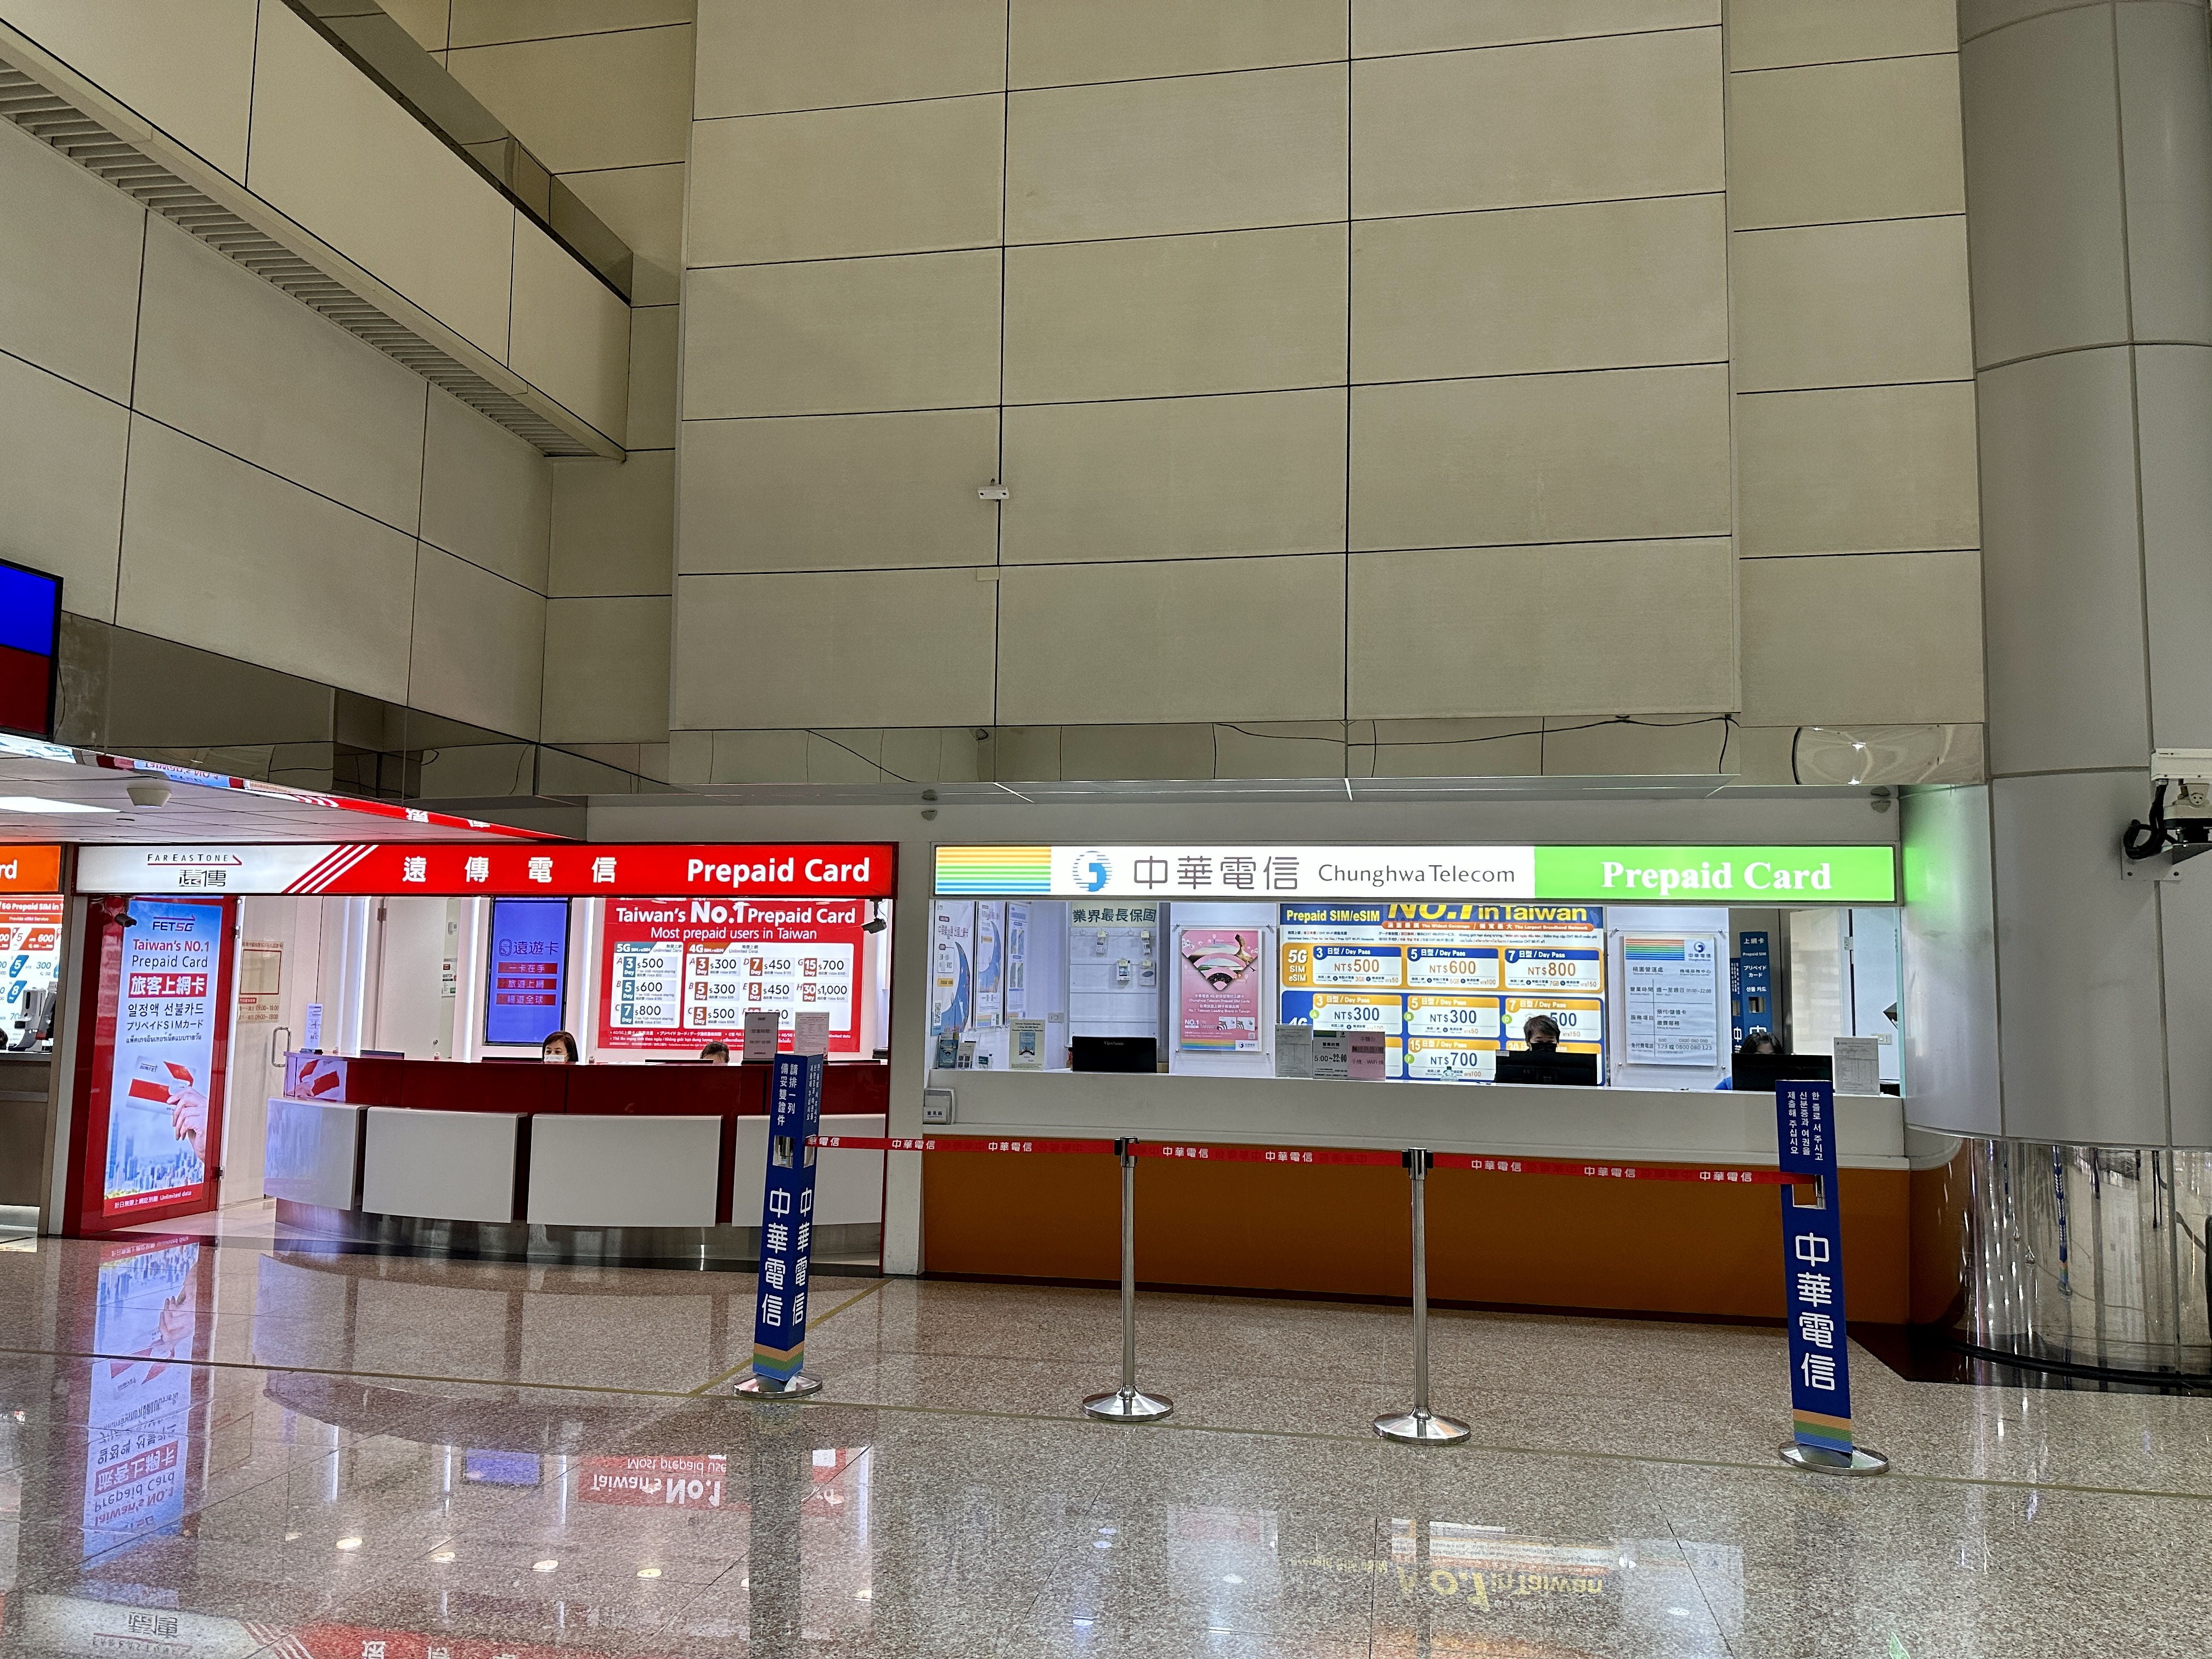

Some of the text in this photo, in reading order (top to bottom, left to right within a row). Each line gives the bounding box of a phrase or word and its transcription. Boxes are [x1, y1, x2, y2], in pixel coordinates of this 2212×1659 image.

[148, 854, 228, 862] FAREASTONE
[402, 856, 617, 883] 遠傳電信
[687, 857, 870, 888] Prepaid Card
[1133, 855, 1300, 890] 中華電信
[1318, 864, 1515, 887] Chunghwa Telecom
[179, 870, 226, 887] 遠傳
[1600, 861, 1833, 896] Prepaid Card
[12, 902, 38, 912] Prepaid
[616, 901, 856, 927] Taiwan's No.1 Prepaid Card
[1072, 908, 1157, 923] 業界最長保固
[1286, 910, 1327, 923] Prepaid
[1330, 910, 1380, 922] SIM/eSIM
[1500, 905, 1587, 921] Taiwan
[650, 927, 817, 941] Most prepaid users in Taiwan
[133, 939, 209, 952] Taiwan's NO.1
[513, 940, 559, 955] 遠遊卡
[616, 943, 631, 952] 5G
[689, 944, 704, 953] 4G
[1288, 949, 1308, 963] 5G
[1316, 947, 1324, 958] 3
[1410, 949, 1418, 960] 5
[1508, 950, 1516, 961] 7
[132, 955, 207, 970] Prepaid Card
[509, 964, 545, 973] 一卡在手
[625, 958, 633, 969] 3
[637, 958, 663, 969] $500
[710, 959, 737, 969] $300
[764, 960, 791, 970] $450
[804, 960, 844, 970] 15 $700
[1289, 965, 1306, 973] SIM
[1334, 959, 1380, 973] NT$500
[1429, 960, 1476, 974] NT$600
[1528, 962, 1576, 977] NT$800
[1288, 974, 1306, 982] eSIM
[130, 976, 205, 995] 旅客上網卡
[624, 981, 632, 992] 5
[636, 982, 663, 992] $600
[709, 984, 736, 994] $300
[763, 984, 789, 995] $450
[803, 985, 848, 996] 30 $1,000
[128, 1002, 204, 1017] 일정액 선불카드
[624, 1005, 631, 1016] 7
[635, 1005, 662, 1016] $800
[708, 1008, 735, 1019] $500
[1334, 1007, 1380, 1021] NT$300
[1430, 1009, 1477, 1024] NT$300
[1410, 1040, 1421, 1051] 15
[1430, 1052, 1478, 1066] NT$700
[777, 1063, 789, 1126] 備妥雙證件
[787, 1063, 799, 1114] 請排一列
[1787, 1091, 1797, 1118] 제출해
[1799, 1091, 1810, 1155] 신분증과 여권을
[1812, 1092, 1824, 1161] 한 줄로 서 주시고
[891, 1139, 935, 1150] 中華電信
[988, 1142, 1032, 1152] 中華電信
[1163, 1146, 1209, 1159] 中華電信
[1265, 1151, 1313, 1163] 中華電信
[1471, 1159, 1522, 1172] 中華電信
[1584, 1166, 1636, 1178] 中華電信
[1700, 1171, 1752, 1183] 中華電信
[761, 1188, 791, 1327] 中華電信
[792, 1187, 812, 1326] 中華電信
[1795, 1232, 1836, 1390] 中華電信
